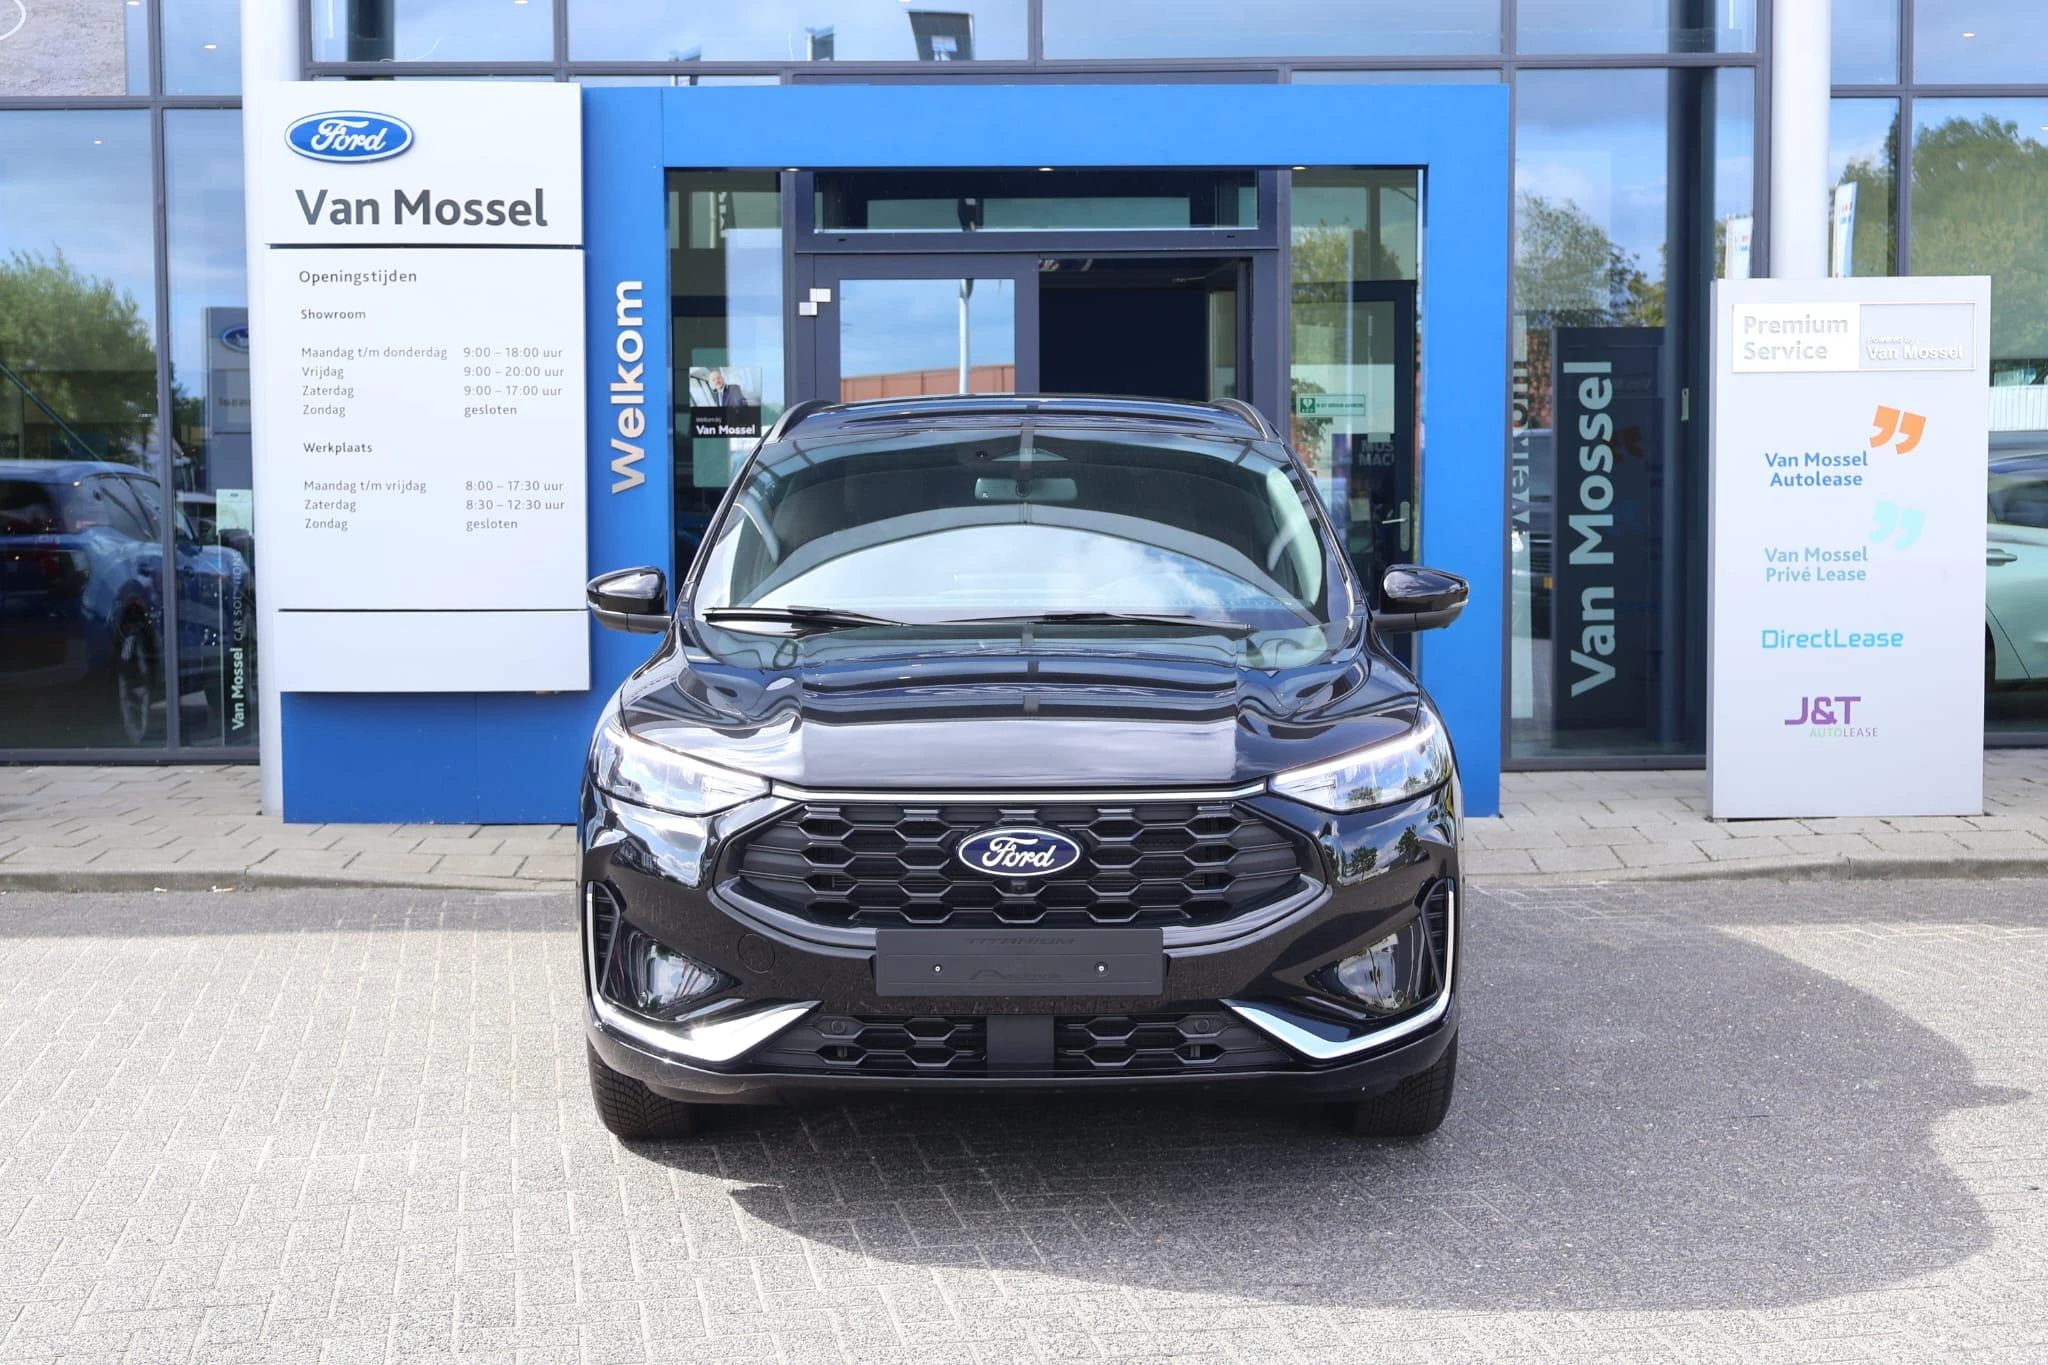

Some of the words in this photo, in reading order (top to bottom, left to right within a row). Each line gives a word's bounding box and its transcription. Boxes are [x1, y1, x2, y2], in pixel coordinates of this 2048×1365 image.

[310, 118, 388, 151] Ford
[295, 189, 380, 226] Van
[394, 187, 549, 227] Mossel
[298, 269, 417, 287] Openingstijden
[300, 308, 366, 320] Showroom
[1743, 313, 1848, 335] Premium
[301, 346, 355, 361] Maandag
[357, 347, 380, 358] t/m
[383, 346, 448, 361] donderdag
[463, 346, 491, 358] 9:00
[505, 346, 539, 358] 18:00
[543, 349, 563, 358] uur
[1743, 339, 1828, 361] Service
[1867, 345, 1899, 361] Van
[1903, 344, 1963, 361] Mossel
[301, 365, 345, 380] Vrijdag
[463, 365, 492, 377] 9:00
[505, 366, 541, 377] 20:00
[544, 368, 565, 377] uur
[302, 384, 355, 399] Zaterdag
[463, 385, 492, 397] 9:00
[505, 384, 539, 397] 17:00
[542, 387, 563, 397] uur
[609, 280, 646, 495] Welkom
[302, 403, 346, 418] Zondag
[463, 403, 517, 418] gesloten
[696, 425, 716, 435] Van
[718, 424, 756, 435] Mossel
[303, 441, 373, 456] Werkplaats
[1563, 361, 1614, 565] Mossel
[1764, 452, 1799, 468] Van
[1804, 450, 1869, 468] Mossel
[304, 479, 357, 494] Maandag
[360, 479, 382, 491] t/m
[385, 479, 427, 495] vrijdag
[465, 480, 494, 492] 8:00
[507, 480, 540, 492] 17:30
[543, 482, 564, 492] uur
[1769, 470, 1863, 487] Autolease
[304, 499, 357, 513] Zaterdag
[466, 499, 494, 511] 8:30
[507, 499, 542, 511] 12:30
[545, 501, 565, 511] uur
[304, 517, 348, 532] Zondag
[465, 518, 518, 531] gesloten
[1764, 547, 1799, 563] Van
[1804, 545, 1869, 562] Mossel
[1765, 566, 1811, 582] Privé
[1816, 566, 1867, 582] Lease
[232, 618, 243, 642] CAR
[1761, 629, 1904, 649] DirectLease
[1570, 586, 1616, 697] Van
[230, 647, 244, 700] Mossel
[232, 702, 245, 731] Van
[1784, 695, 1862, 726] J&T
[1810, 727, 1878, 738] AUTOLEASE
[981, 836, 1057, 867] Ford
